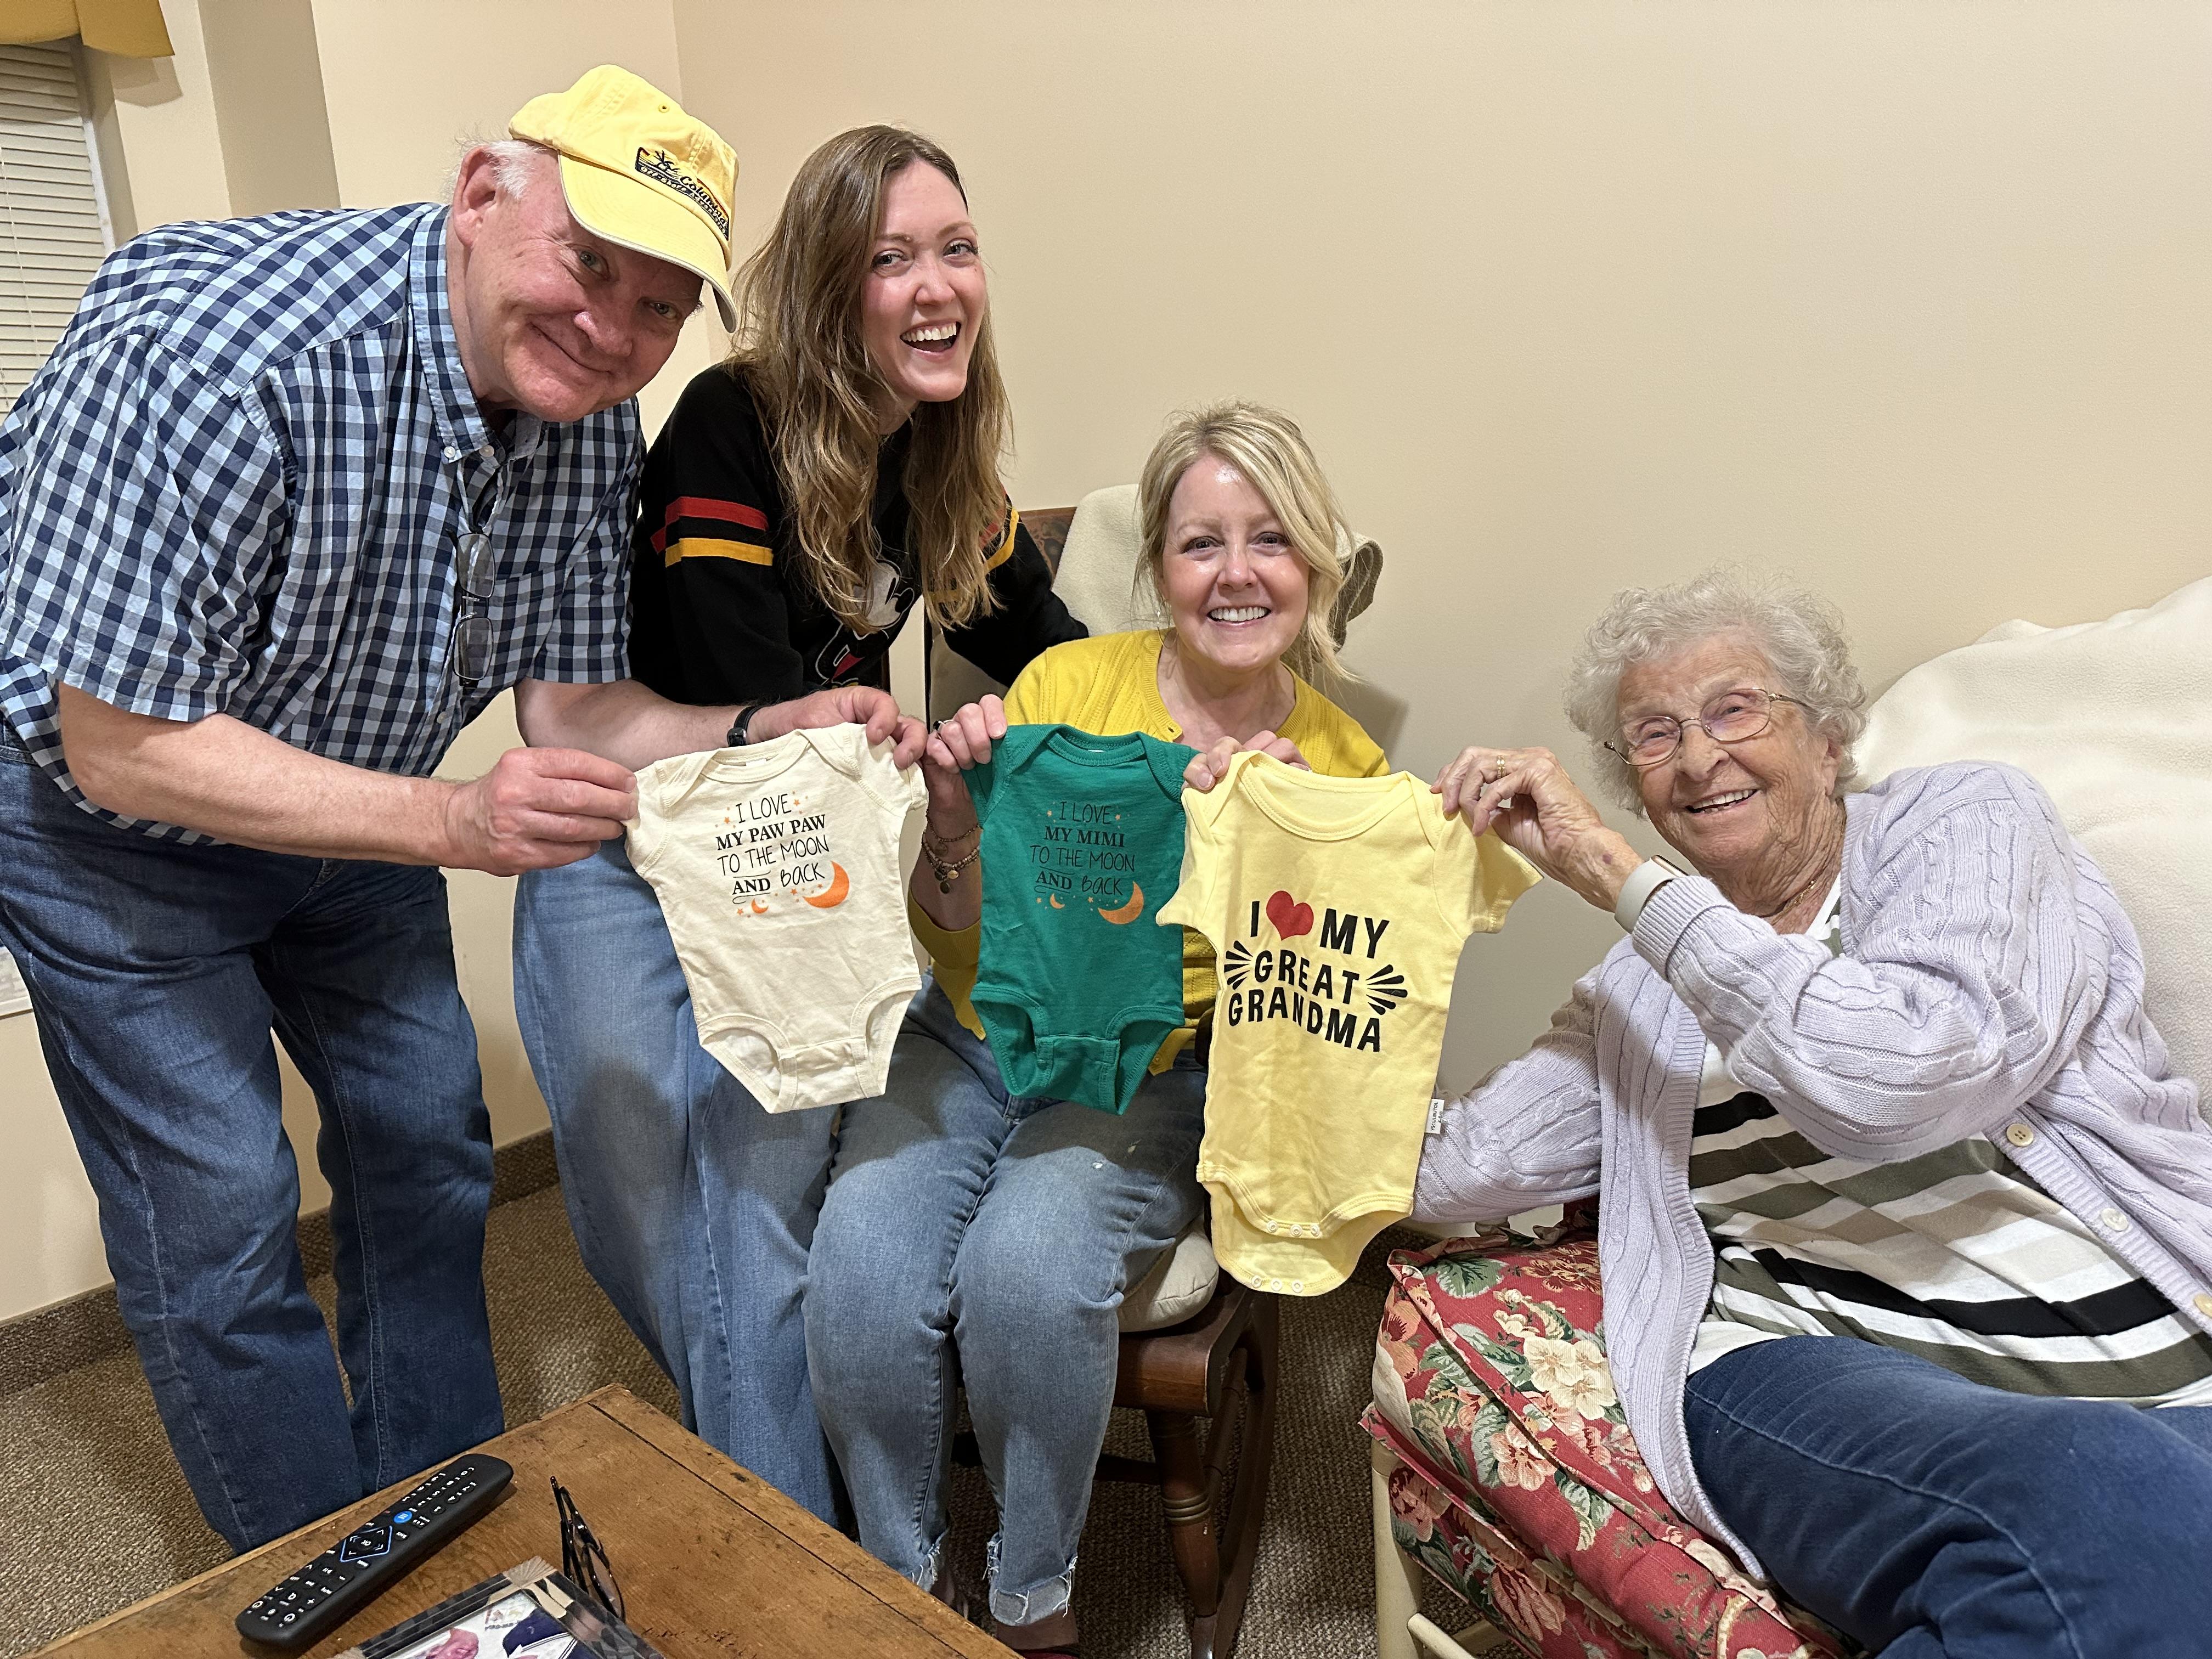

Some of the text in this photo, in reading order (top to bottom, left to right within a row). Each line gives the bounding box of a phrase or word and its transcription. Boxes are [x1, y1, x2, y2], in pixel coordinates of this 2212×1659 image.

[679, 176, 727, 227] Columbia
[736, 793, 792, 823] I LOVE
[1059, 801, 1112, 825] I LOVE
[715, 814, 826, 851] MY PAW PAW
[1044, 825, 1125, 848] MY MIMI
[717, 834, 830, 876] TO THE MOON
[1030, 845, 1136, 872] TO THE MOON
[732, 878, 771, 895] AND
[1035, 871, 1072, 890] AND
[1250, 900, 1390, 959] I MY
[1254, 949, 1360, 1005] GREAT
[1228, 986, 1380, 1052] GRANDMA
